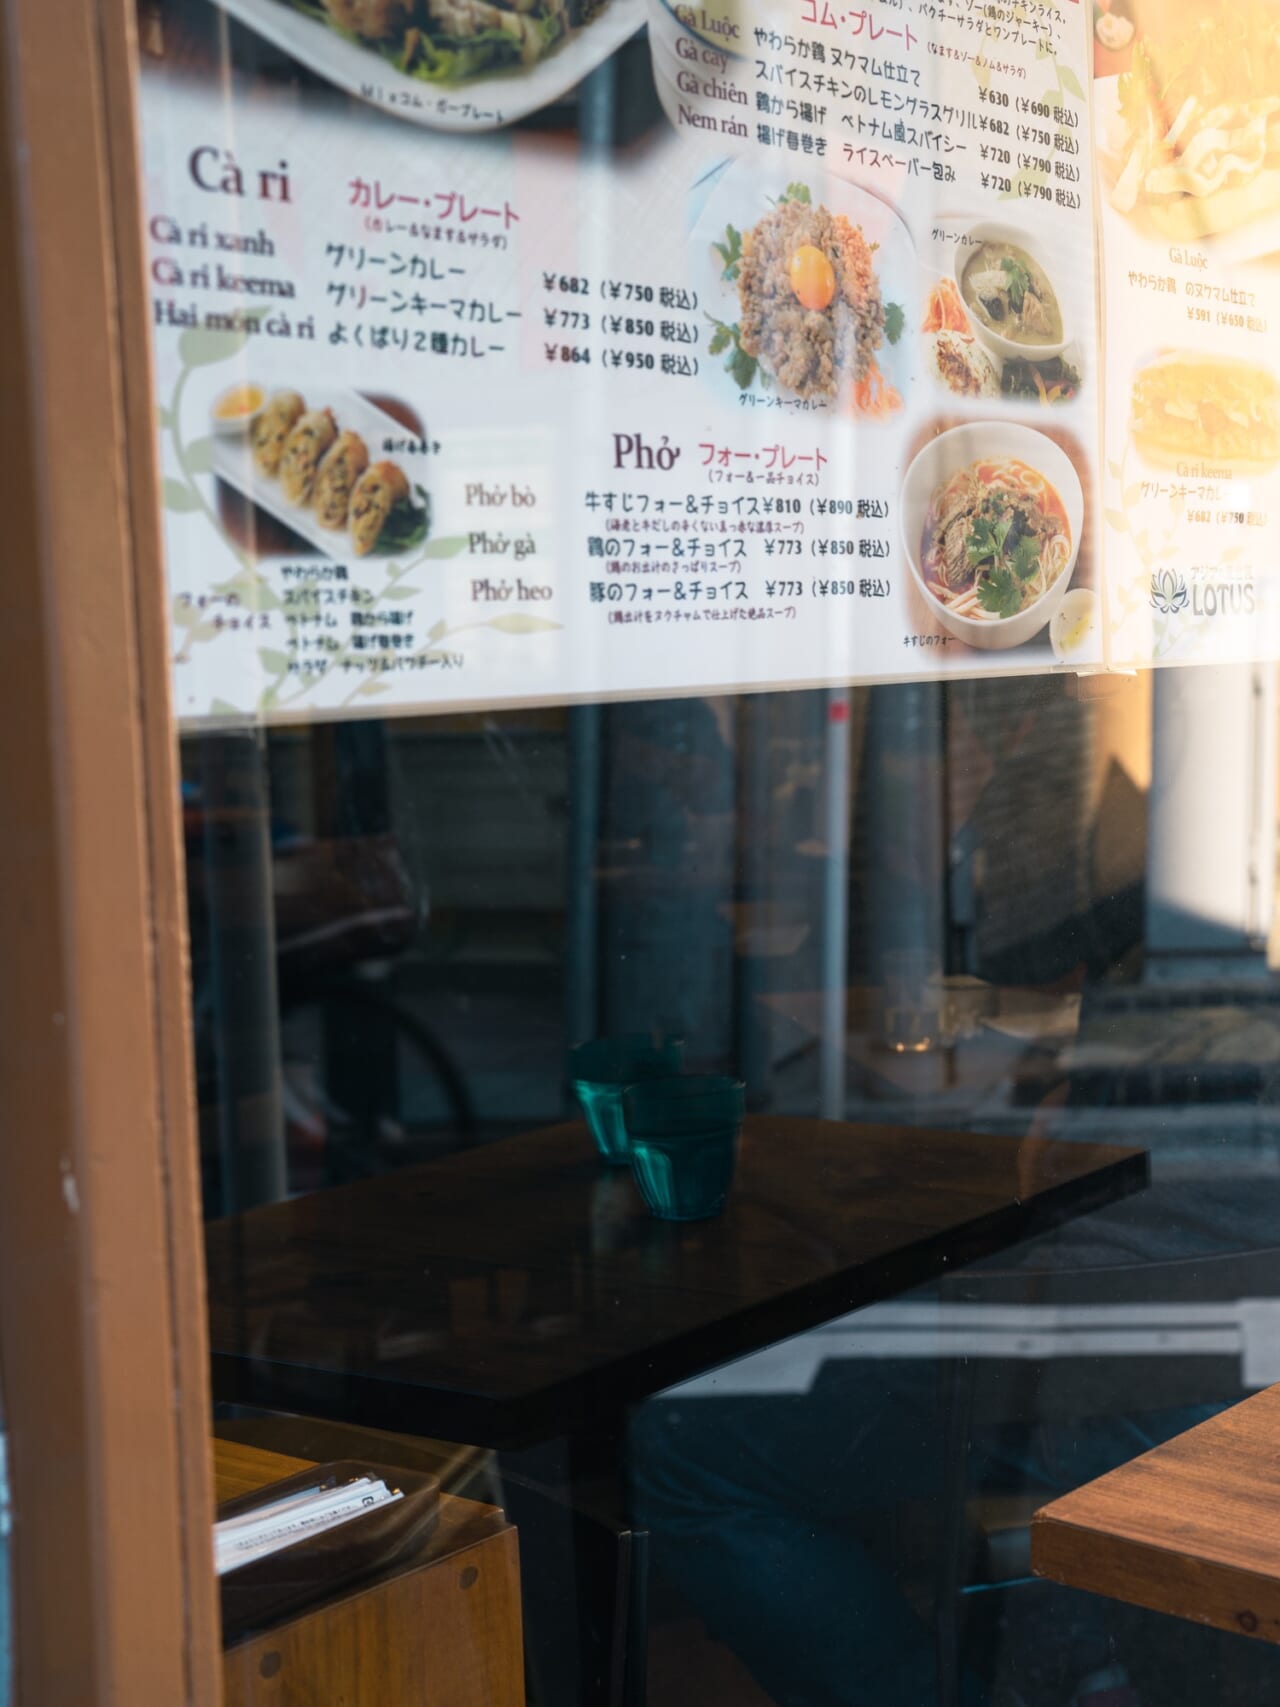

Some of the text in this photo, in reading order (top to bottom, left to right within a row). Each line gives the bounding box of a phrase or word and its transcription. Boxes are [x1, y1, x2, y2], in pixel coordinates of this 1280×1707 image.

[675, 37, 698, 60] Gà
[979, 116, 1010, 137] ¥682
[754, 27, 826, 62] やわらか鶏
[831, 47, 921, 87] ヌクマム仕立て
[978, 86, 1010, 108] ¥630
[677, 71, 698, 95] Gà
[703, 78, 748, 105] chiên
[756, 91, 827, 125] 鶏から揚げ
[841, 113, 967, 153] ベトナム風スパイシー
[979, 144, 1011, 164] ¥720
[188, 145, 292, 202] Cà ri
[678, 104, 717, 131] Nem
[722, 115, 749, 138] rán
[757, 123, 828, 156] 揚げ春巻き
[980, 173, 1011, 193] ¥720
[348, 177, 520, 230] カレー・プレート
[149, 214, 698, 311] Cà ri xanh グリーンカレー ¥682 (¥750 税込)
[151, 257, 699, 343] Cà ri keema グリーンキーマカレー ¥773 (¥850 税込)
[154, 300, 198, 329] Hai
[265, 311, 292, 337] cà
[297, 315, 316, 341] ri
[328, 322, 506, 359] よくばり2種カレー
[544, 342, 591, 365] ¥864
[602, 349, 655, 370] (¥950
[660, 353, 700, 376] 税込)
[612, 432, 829, 471] Phở フォー・プレート
[464, 482, 536, 509] Phở bò
[584, 490, 889, 519] 牛すじフォー&チョイス ¥810 (¥890 税込)
[468, 530, 536, 561] Phở gà
[588, 536, 891, 559] 鶏のフォー&チョイス ¥773 (¥850 税込)
[471, 577, 553, 603] Phở heo
[765, 580, 804, 598] ¥773
[811, 580, 856, 598] (¥850
[859, 579, 891, 599] 税込)
[1193, 582, 1256, 617] LOTUS
